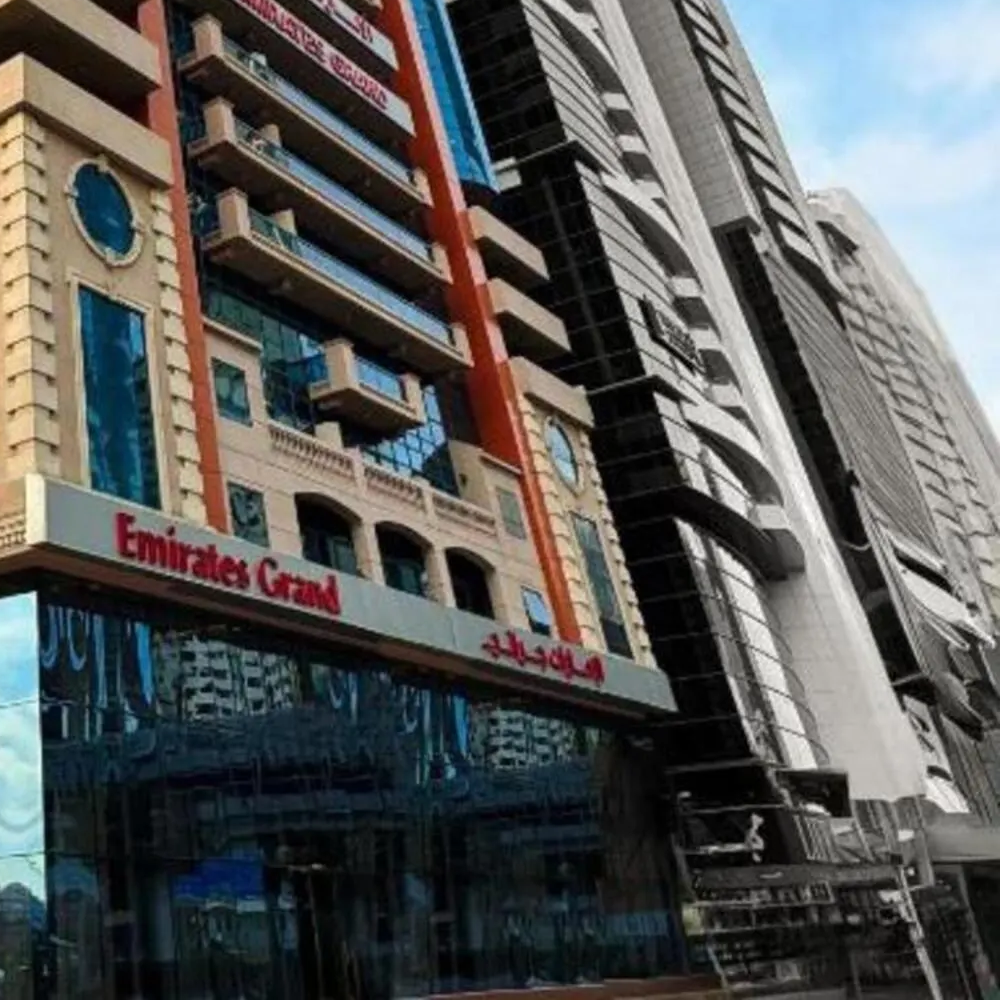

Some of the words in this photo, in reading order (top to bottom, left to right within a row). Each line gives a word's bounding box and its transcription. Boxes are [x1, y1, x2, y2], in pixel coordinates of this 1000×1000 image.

[329, 53, 389, 110] GRAND
[113, 511, 251, 590] Emirates
[256, 556, 342, 616] Grand
